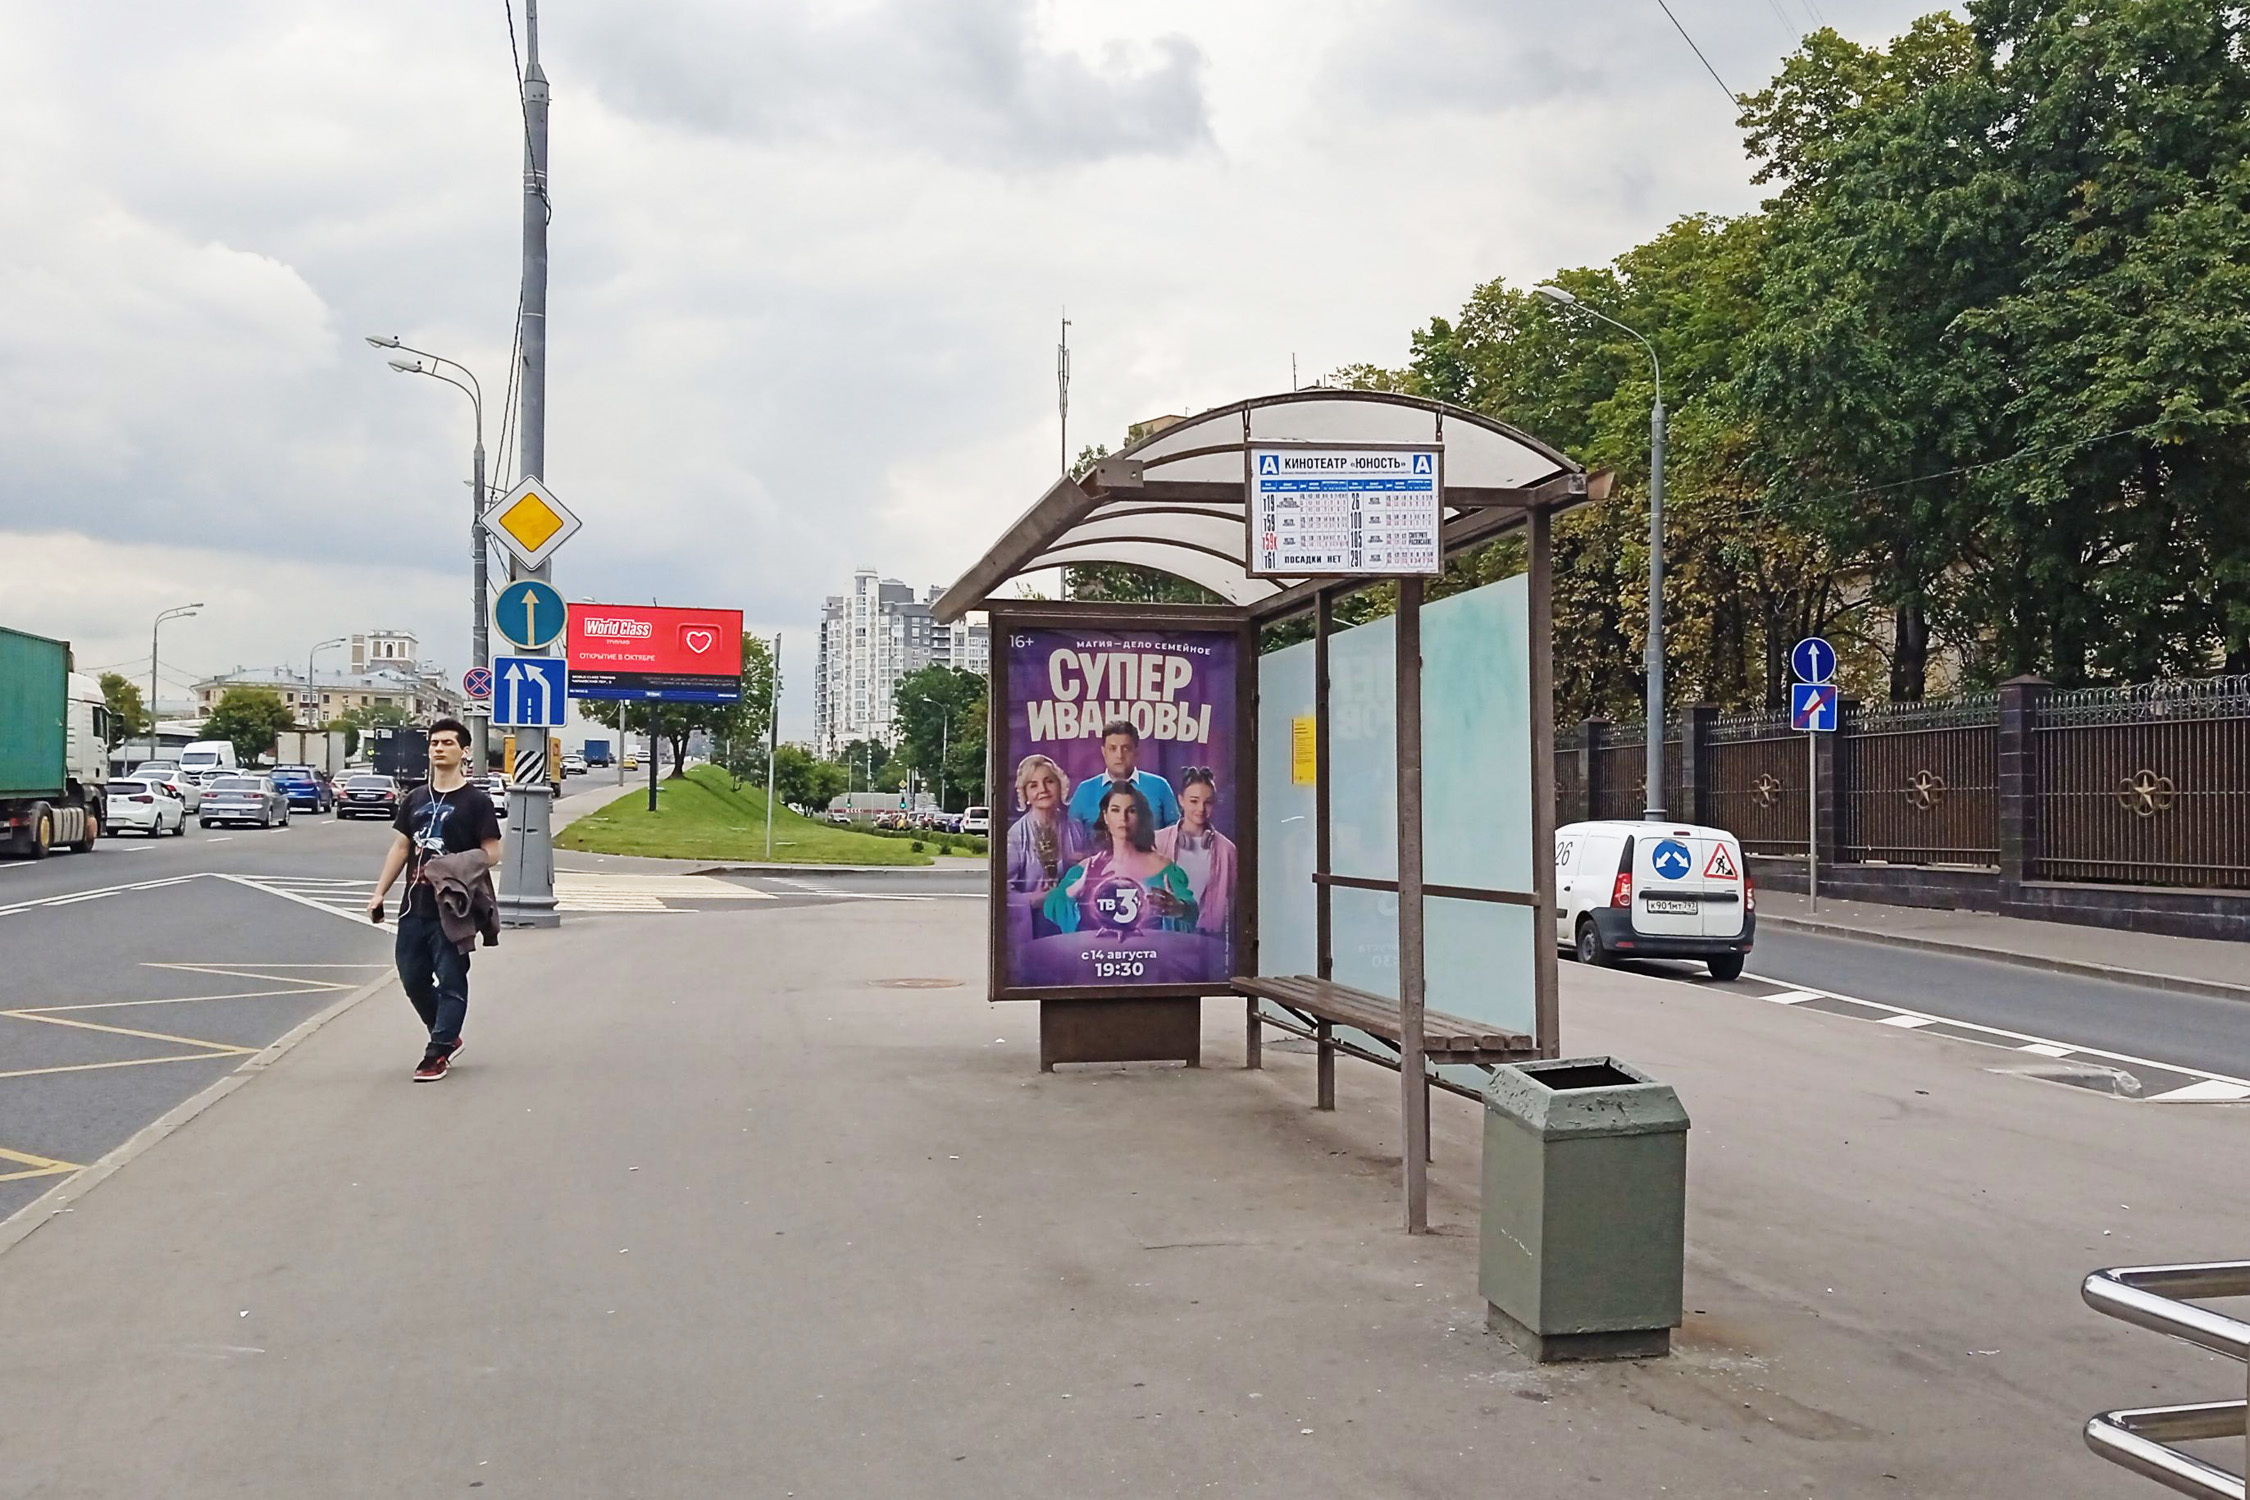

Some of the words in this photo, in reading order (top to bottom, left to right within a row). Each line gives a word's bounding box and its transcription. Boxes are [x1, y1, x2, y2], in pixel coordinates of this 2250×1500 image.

[1285, 458, 1347, 469] КИНОТЕАТР
[1350, 457, 1406, 469] «ЮНОСТЬ»
[1351, 492, 1360, 510] 26
[1285, 555, 1322, 564] ПОСАДКИ
[1327, 555, 1342, 563] НЕТ
[587, 620, 619, 635] World
[620, 622, 650, 636] Class
[1009, 635, 1034, 648] 16+
[1076, 641, 1113, 649] МАГИЯ
[1123, 641, 1152, 649] ДЕЛО
[1154, 643, 1212, 655] СЕМЕЙНОЕ
[579, 652, 616, 660] ОТКРЫТИЕ
[624, 654, 655, 662] ОКТЯБРЕ
[1049, 649, 1193, 702] СУПЕР
[1081, 951, 1089, 960] с
[1090, 950, 1104, 960] 14
[1107, 951, 1157, 961] августа
[1095, 962, 1144, 977] 19:30
